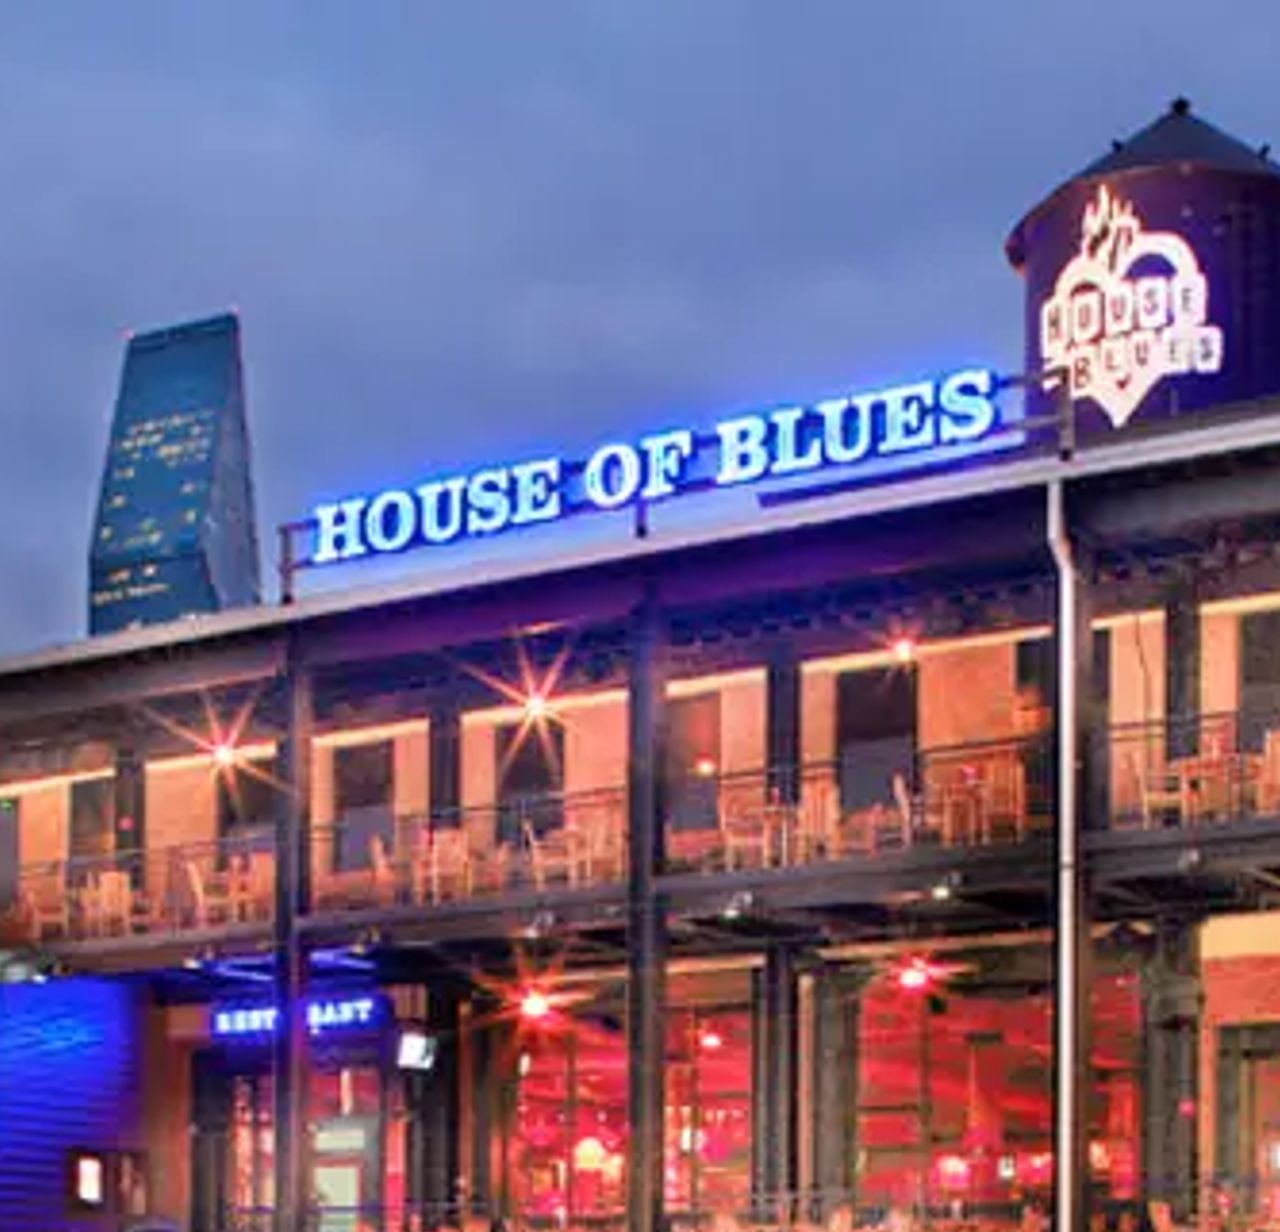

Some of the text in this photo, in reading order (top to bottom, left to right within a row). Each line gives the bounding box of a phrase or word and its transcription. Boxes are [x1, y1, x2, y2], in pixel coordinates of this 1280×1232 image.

[1045, 281, 1199, 344] HOUSE
[313, 370, 996, 562] HOUSE OF BLUES
